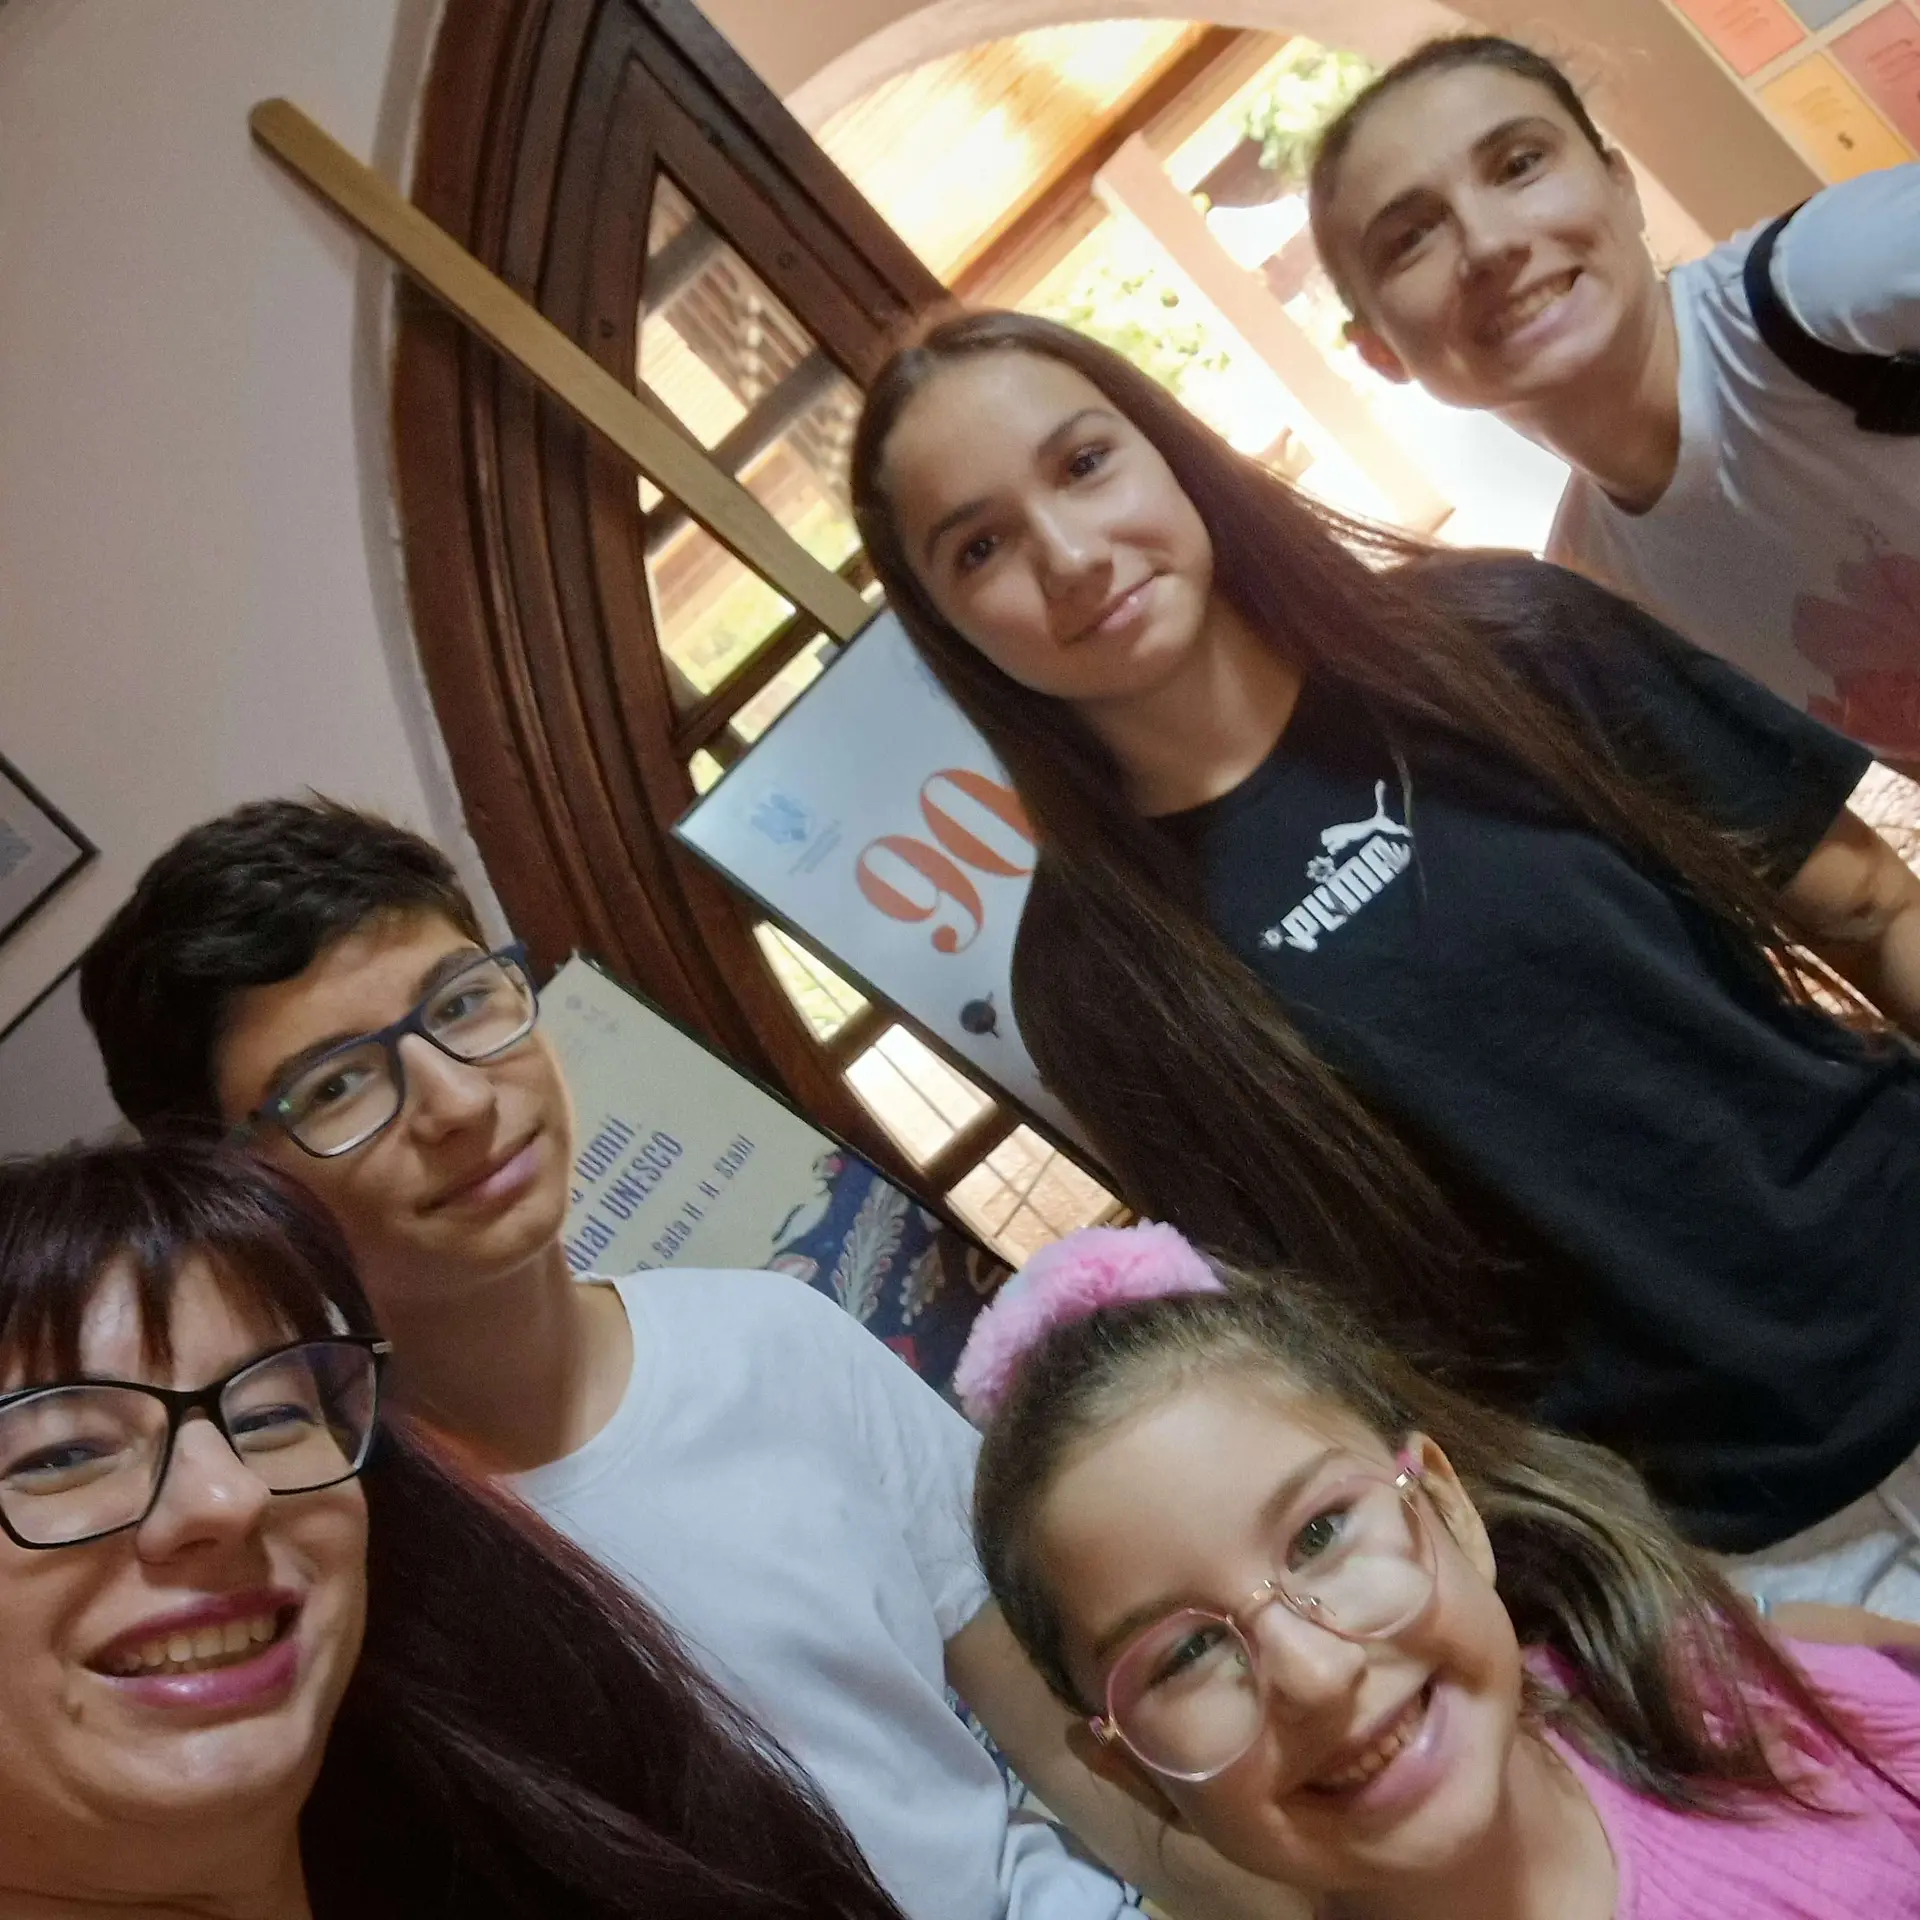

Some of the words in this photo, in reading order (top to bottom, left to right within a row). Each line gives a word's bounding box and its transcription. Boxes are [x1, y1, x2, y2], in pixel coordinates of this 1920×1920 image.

[856, 768, 1044, 955] 90
[1280, 835, 1412, 952] PUMA
[563, 1211, 617, 1272] dial
[600, 1129, 684, 1222] UNESCO
